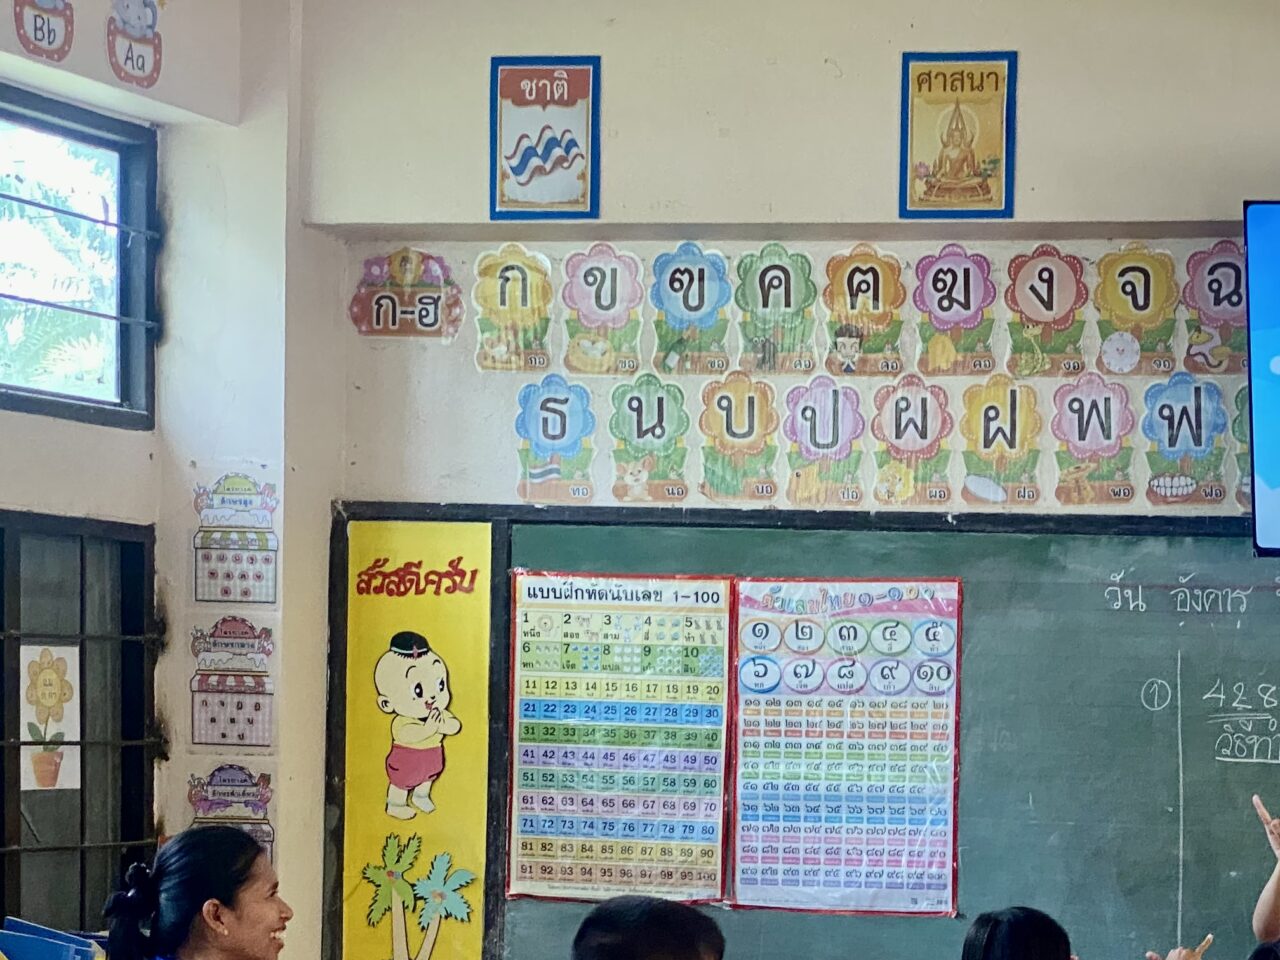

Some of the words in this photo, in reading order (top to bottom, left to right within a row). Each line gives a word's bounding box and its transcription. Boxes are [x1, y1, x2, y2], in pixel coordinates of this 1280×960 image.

[33, 14, 57, 46] Bb
[124, 43, 146, 73] Aa
[520, 70, 570, 100] ชาติ
[916, 65, 999, 94] ศาสนา
[500, 264, 528, 308] ก
[583, 266, 618, 312] ข
[758, 264, 791, 309] ค
[1029, 267, 1054, 311] ง
[1118, 266, 1150, 311] จ
[1207, 261, 1243, 308] ฉ
[373, 293, 440, 329] ก-ฮ
[539, 397, 569, 441] ธ
[627, 395, 667, 440] น
[717, 394, 755, 439] บ
[801, 389, 839, 449] ป
[894, 396, 928, 440] ผ
[983, 389, 1018, 450] ฝ
[1068, 396, 1112, 442] พ
[1158, 386, 1202, 448] ฟ
[356, 556, 479, 597] สวัสดีครับ
[527, 581, 663, 602] แบบฝึกหัดนับเลข
[673, 591, 720, 604] 1-100
[1104, 570, 1147, 613] วัน
[1170, 572, 1254, 614] อังคาร
[523, 613, 529, 623] 1
[563, 613, 572, 624] 2
[604, 614, 612, 626] 3
[644, 616, 652, 626] 4
[685, 617, 693, 627] 5
[522, 642, 531, 653] 6
[563, 643, 571, 654] 7
[603, 644, 611, 656] 8
[643, 645, 651, 656] 9
[683, 646, 699, 658] 10
[1202, 678, 1279, 710] 428
